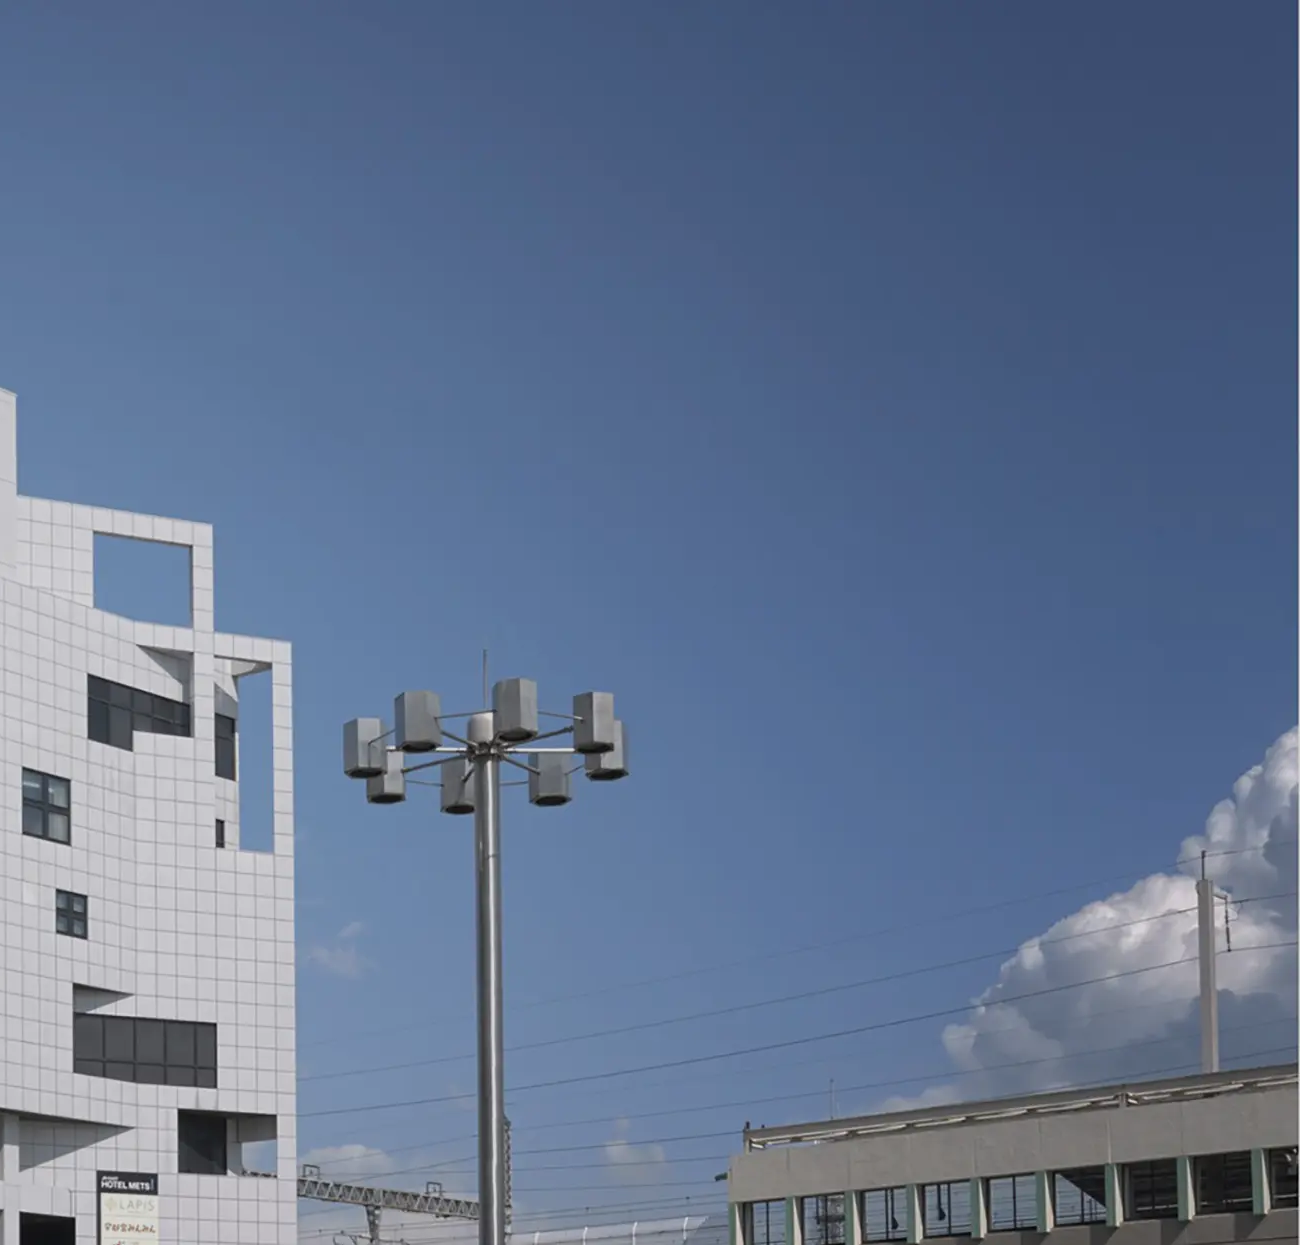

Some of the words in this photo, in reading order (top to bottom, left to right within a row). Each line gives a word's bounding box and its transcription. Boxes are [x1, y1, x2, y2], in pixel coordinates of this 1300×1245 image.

[101, 1180, 127, 1190] HOTEL
[128, 1181, 150, 1191] METS
[119, 1198, 155, 1212] LAPIS
